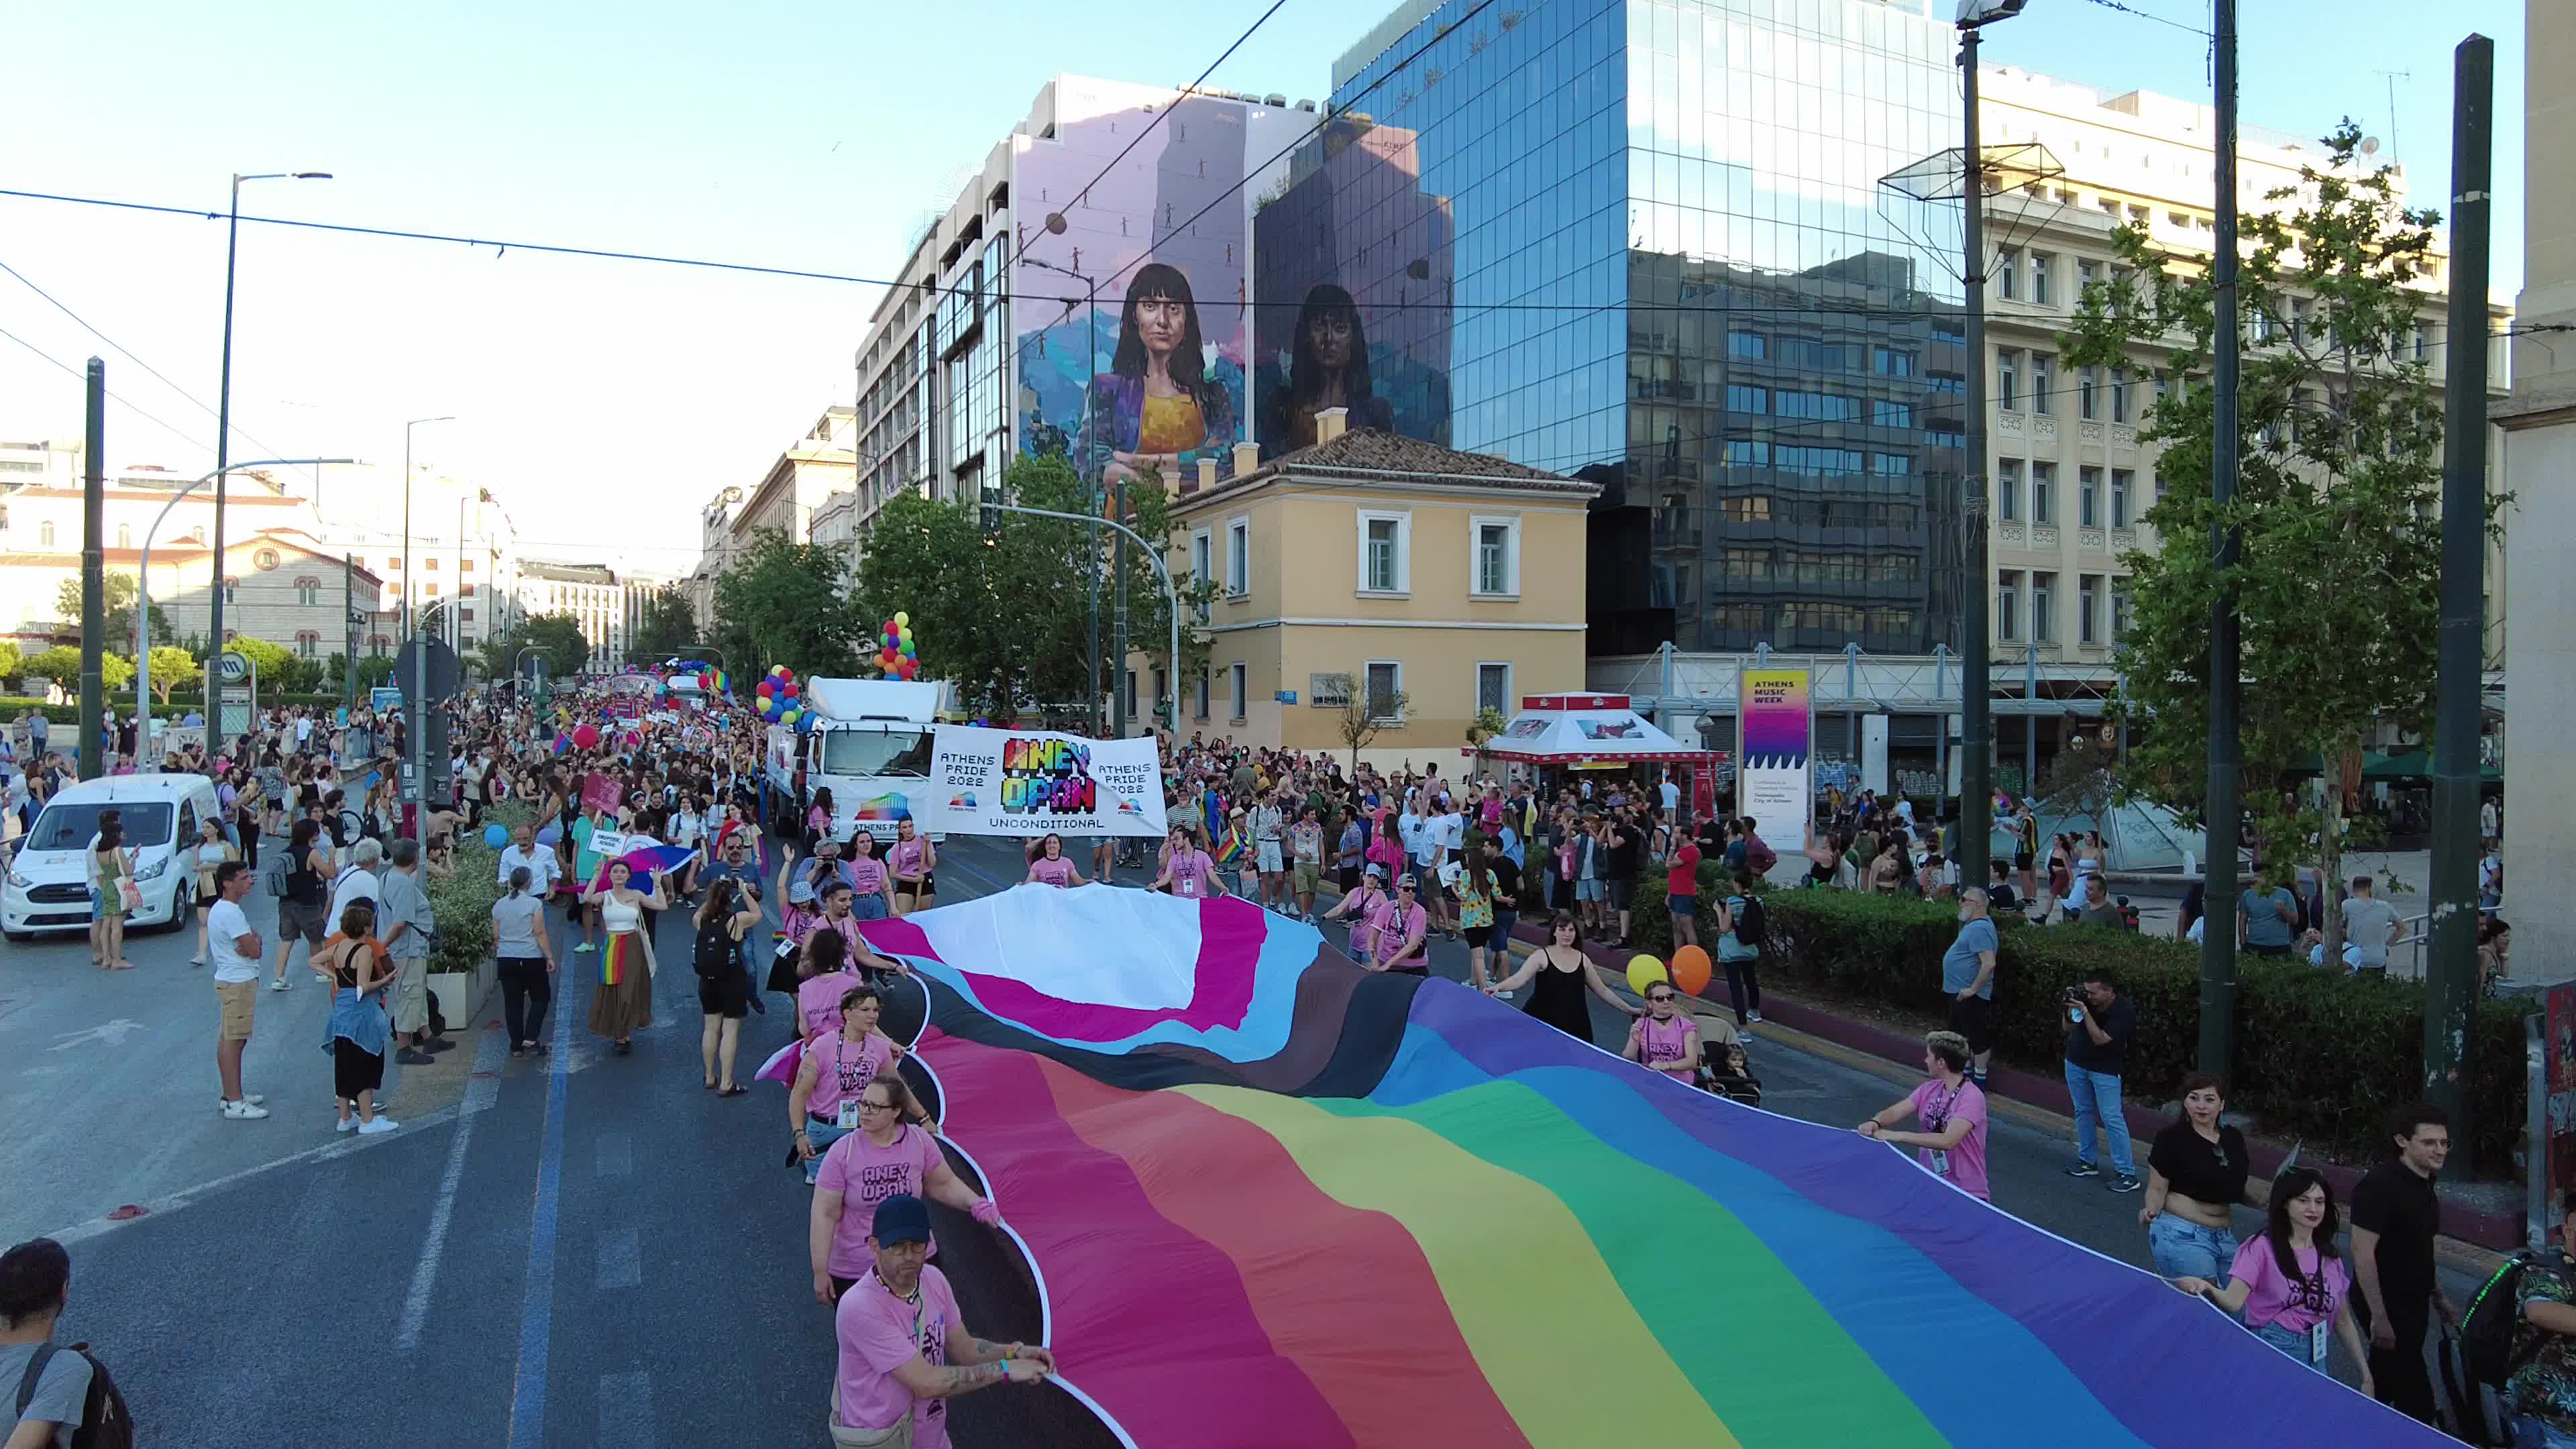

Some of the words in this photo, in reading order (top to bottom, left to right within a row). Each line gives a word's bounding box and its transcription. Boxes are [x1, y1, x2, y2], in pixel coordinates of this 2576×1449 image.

[941, 753, 996, 765] ATHENS
[945, 764, 988, 776] PRIDE
[1099, 763, 1151, 773] ATHENS
[947, 775, 984, 787] 2022
[1105, 774, 1146, 784] PRIDE
[1111, 784, 1144, 794] 2022
[989, 818, 1105, 829] UNCONDITIONAL
